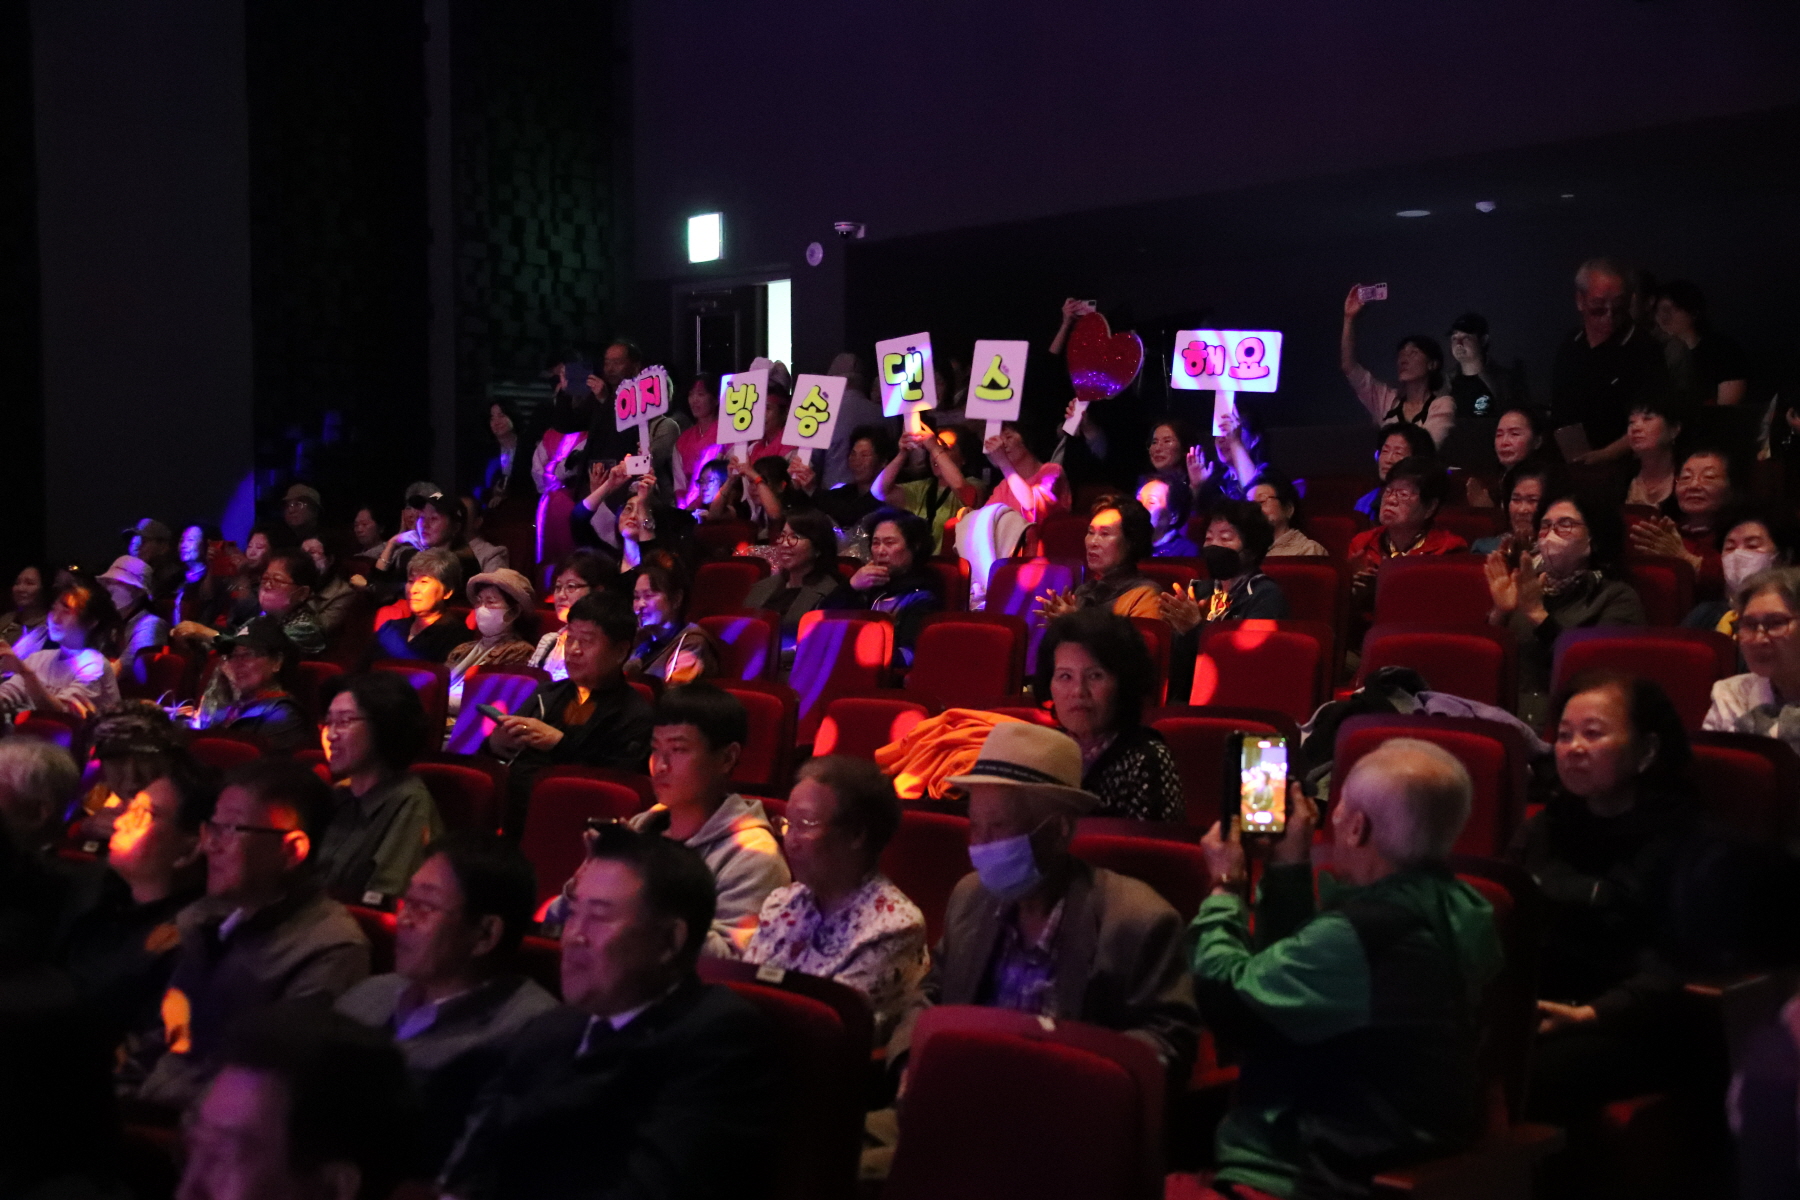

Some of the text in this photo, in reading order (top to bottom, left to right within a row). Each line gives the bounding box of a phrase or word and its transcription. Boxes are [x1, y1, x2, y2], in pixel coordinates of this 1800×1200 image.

[883, 351, 924, 401] 댄
[974, 354, 1014, 401] 스
[1181, 336, 1270, 380] 해요
[617, 375, 661, 420] 이지
[725, 383, 759, 431] 방
[794, 385, 830, 438] 송
